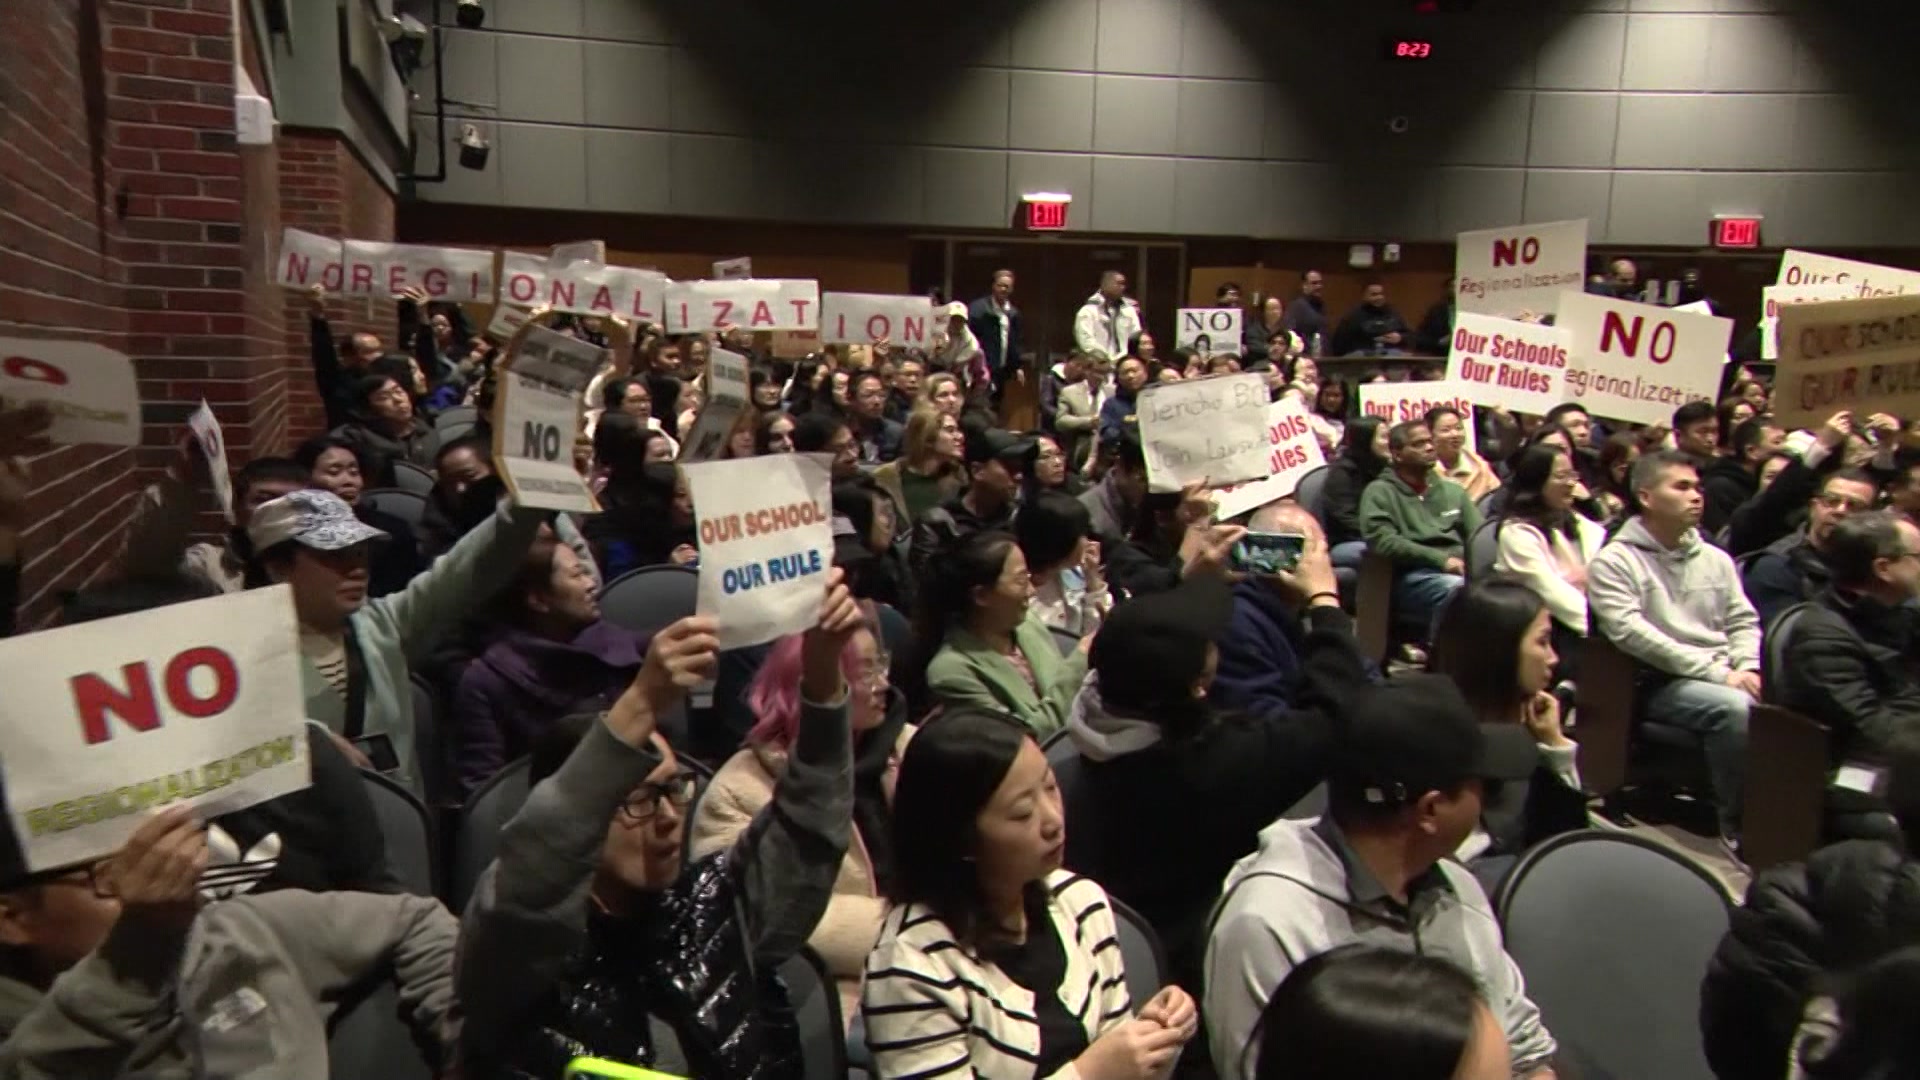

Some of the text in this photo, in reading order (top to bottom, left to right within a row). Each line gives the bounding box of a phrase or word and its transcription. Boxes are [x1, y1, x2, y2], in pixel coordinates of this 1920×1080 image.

[1493, 236, 1539, 268] NO
[1184, 311, 1232, 332] NO
[1600, 311, 1676, 364] NO
[1455, 328, 1568, 369] Our Schools
[1461, 357, 1551, 394] Our Rules
[1365, 400, 1395, 421] Our
[523, 420, 561, 462] NO
[700, 501, 826, 546] OUR SCHOOL
[722, 549, 823, 595] OUR RULE
[70, 645, 241, 745] NO
